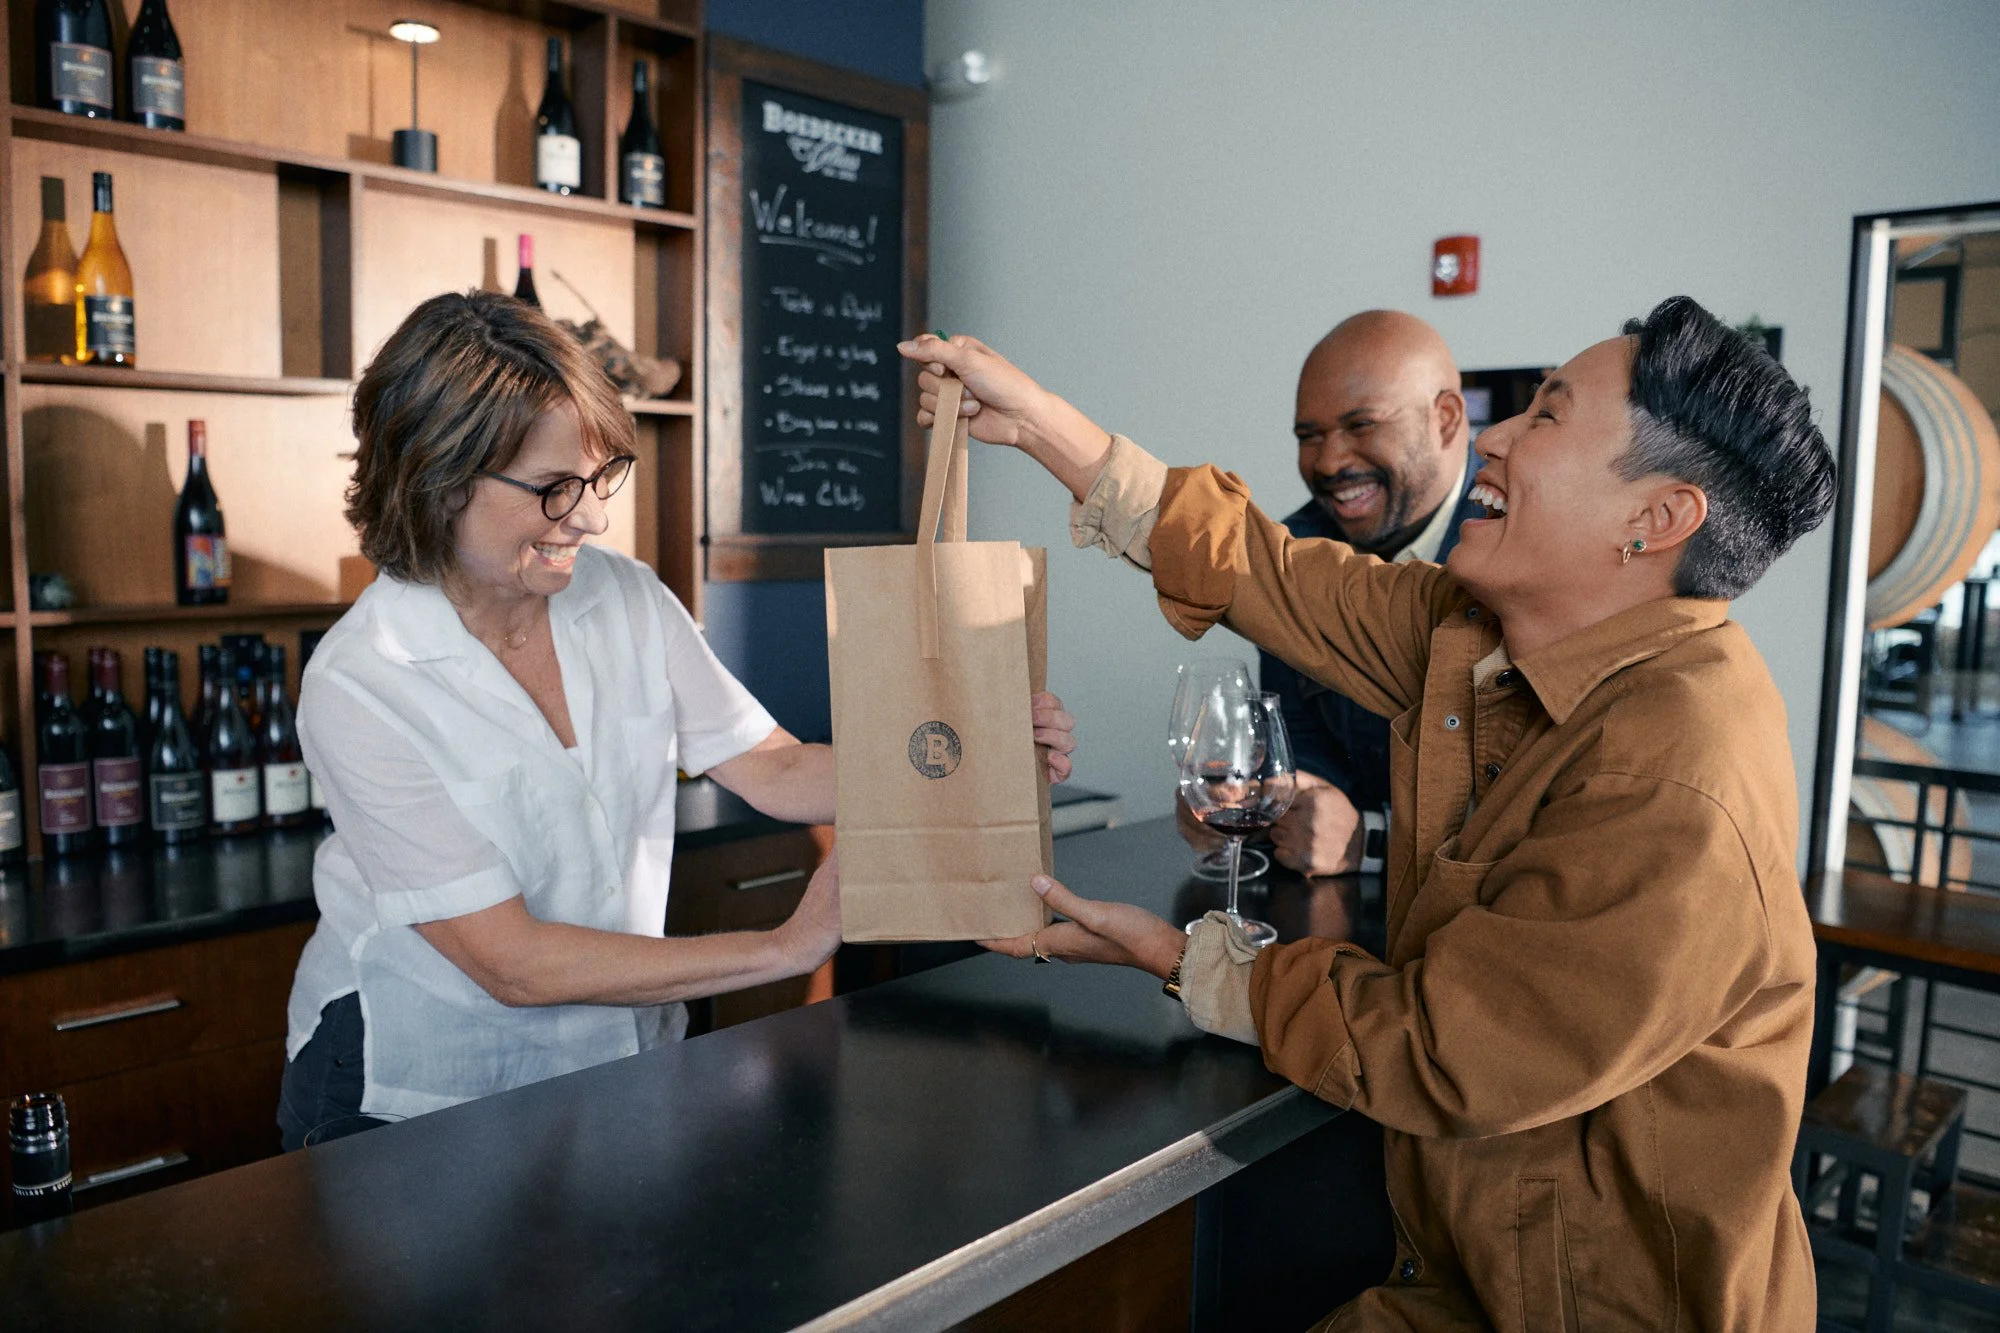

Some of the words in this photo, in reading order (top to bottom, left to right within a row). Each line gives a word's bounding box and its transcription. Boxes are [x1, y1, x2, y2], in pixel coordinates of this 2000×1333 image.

[749, 183, 878, 262] Welcome!
[759, 475, 807, 506] Wine
[815, 479, 865, 511] Club
